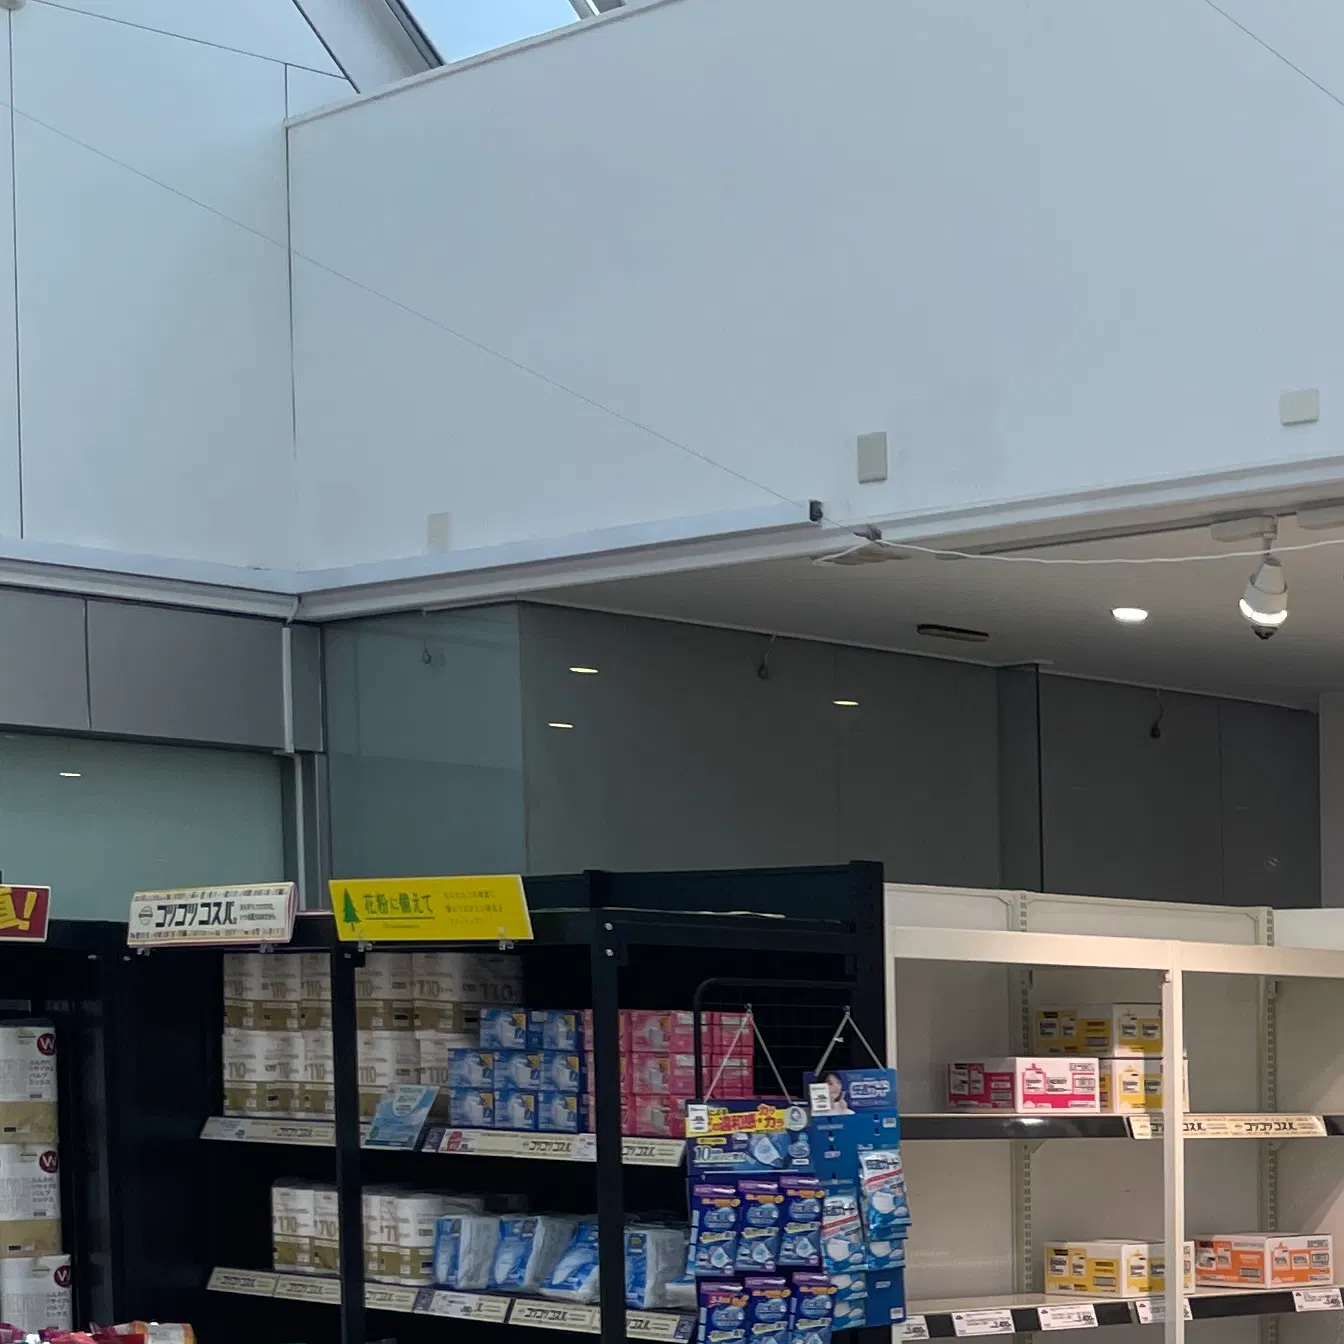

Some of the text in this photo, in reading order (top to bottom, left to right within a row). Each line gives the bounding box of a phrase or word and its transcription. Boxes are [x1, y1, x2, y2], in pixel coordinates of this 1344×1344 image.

[362, 891, 434, 915] 花粉に備えて
